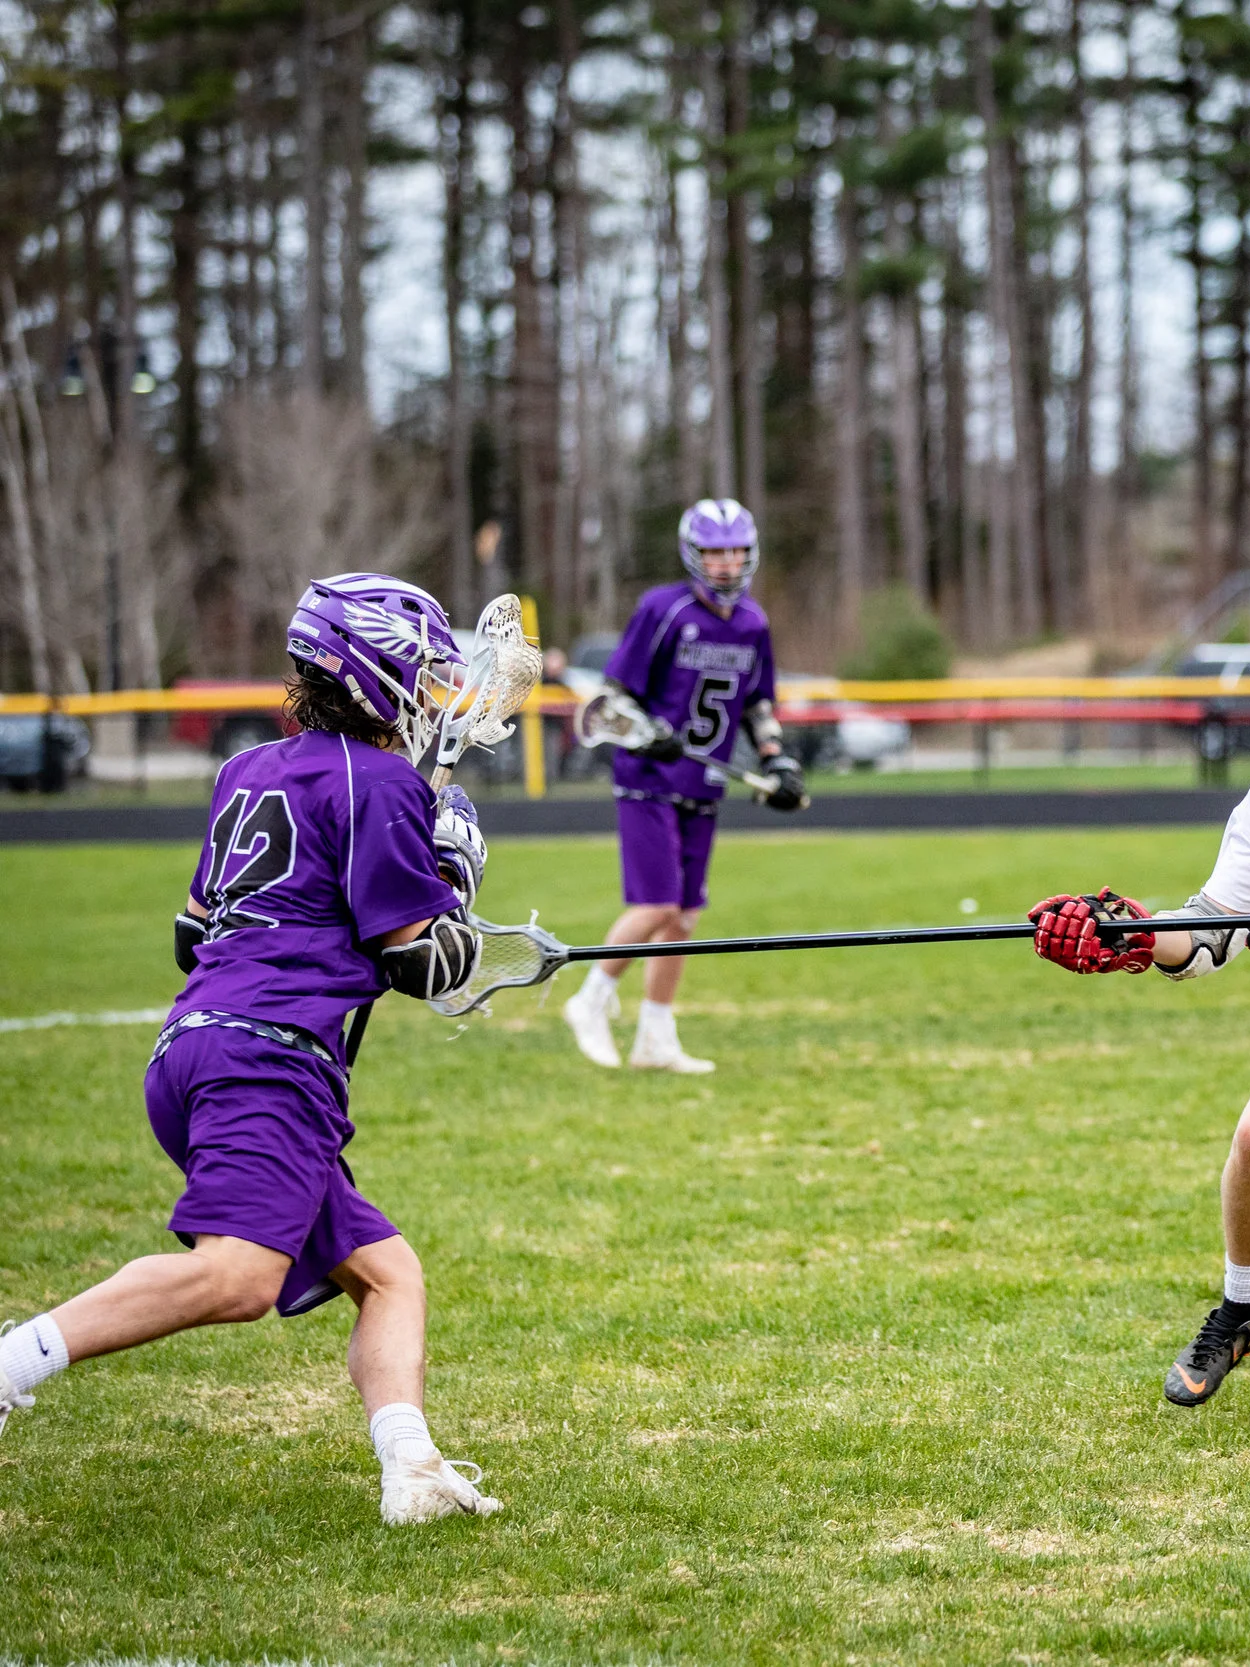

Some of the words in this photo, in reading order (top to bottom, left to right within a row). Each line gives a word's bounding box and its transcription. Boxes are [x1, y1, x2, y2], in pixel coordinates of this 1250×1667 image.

[307, 597, 321, 610] 12
[680, 671, 740, 757] 5
[203, 788, 298, 944] 12
